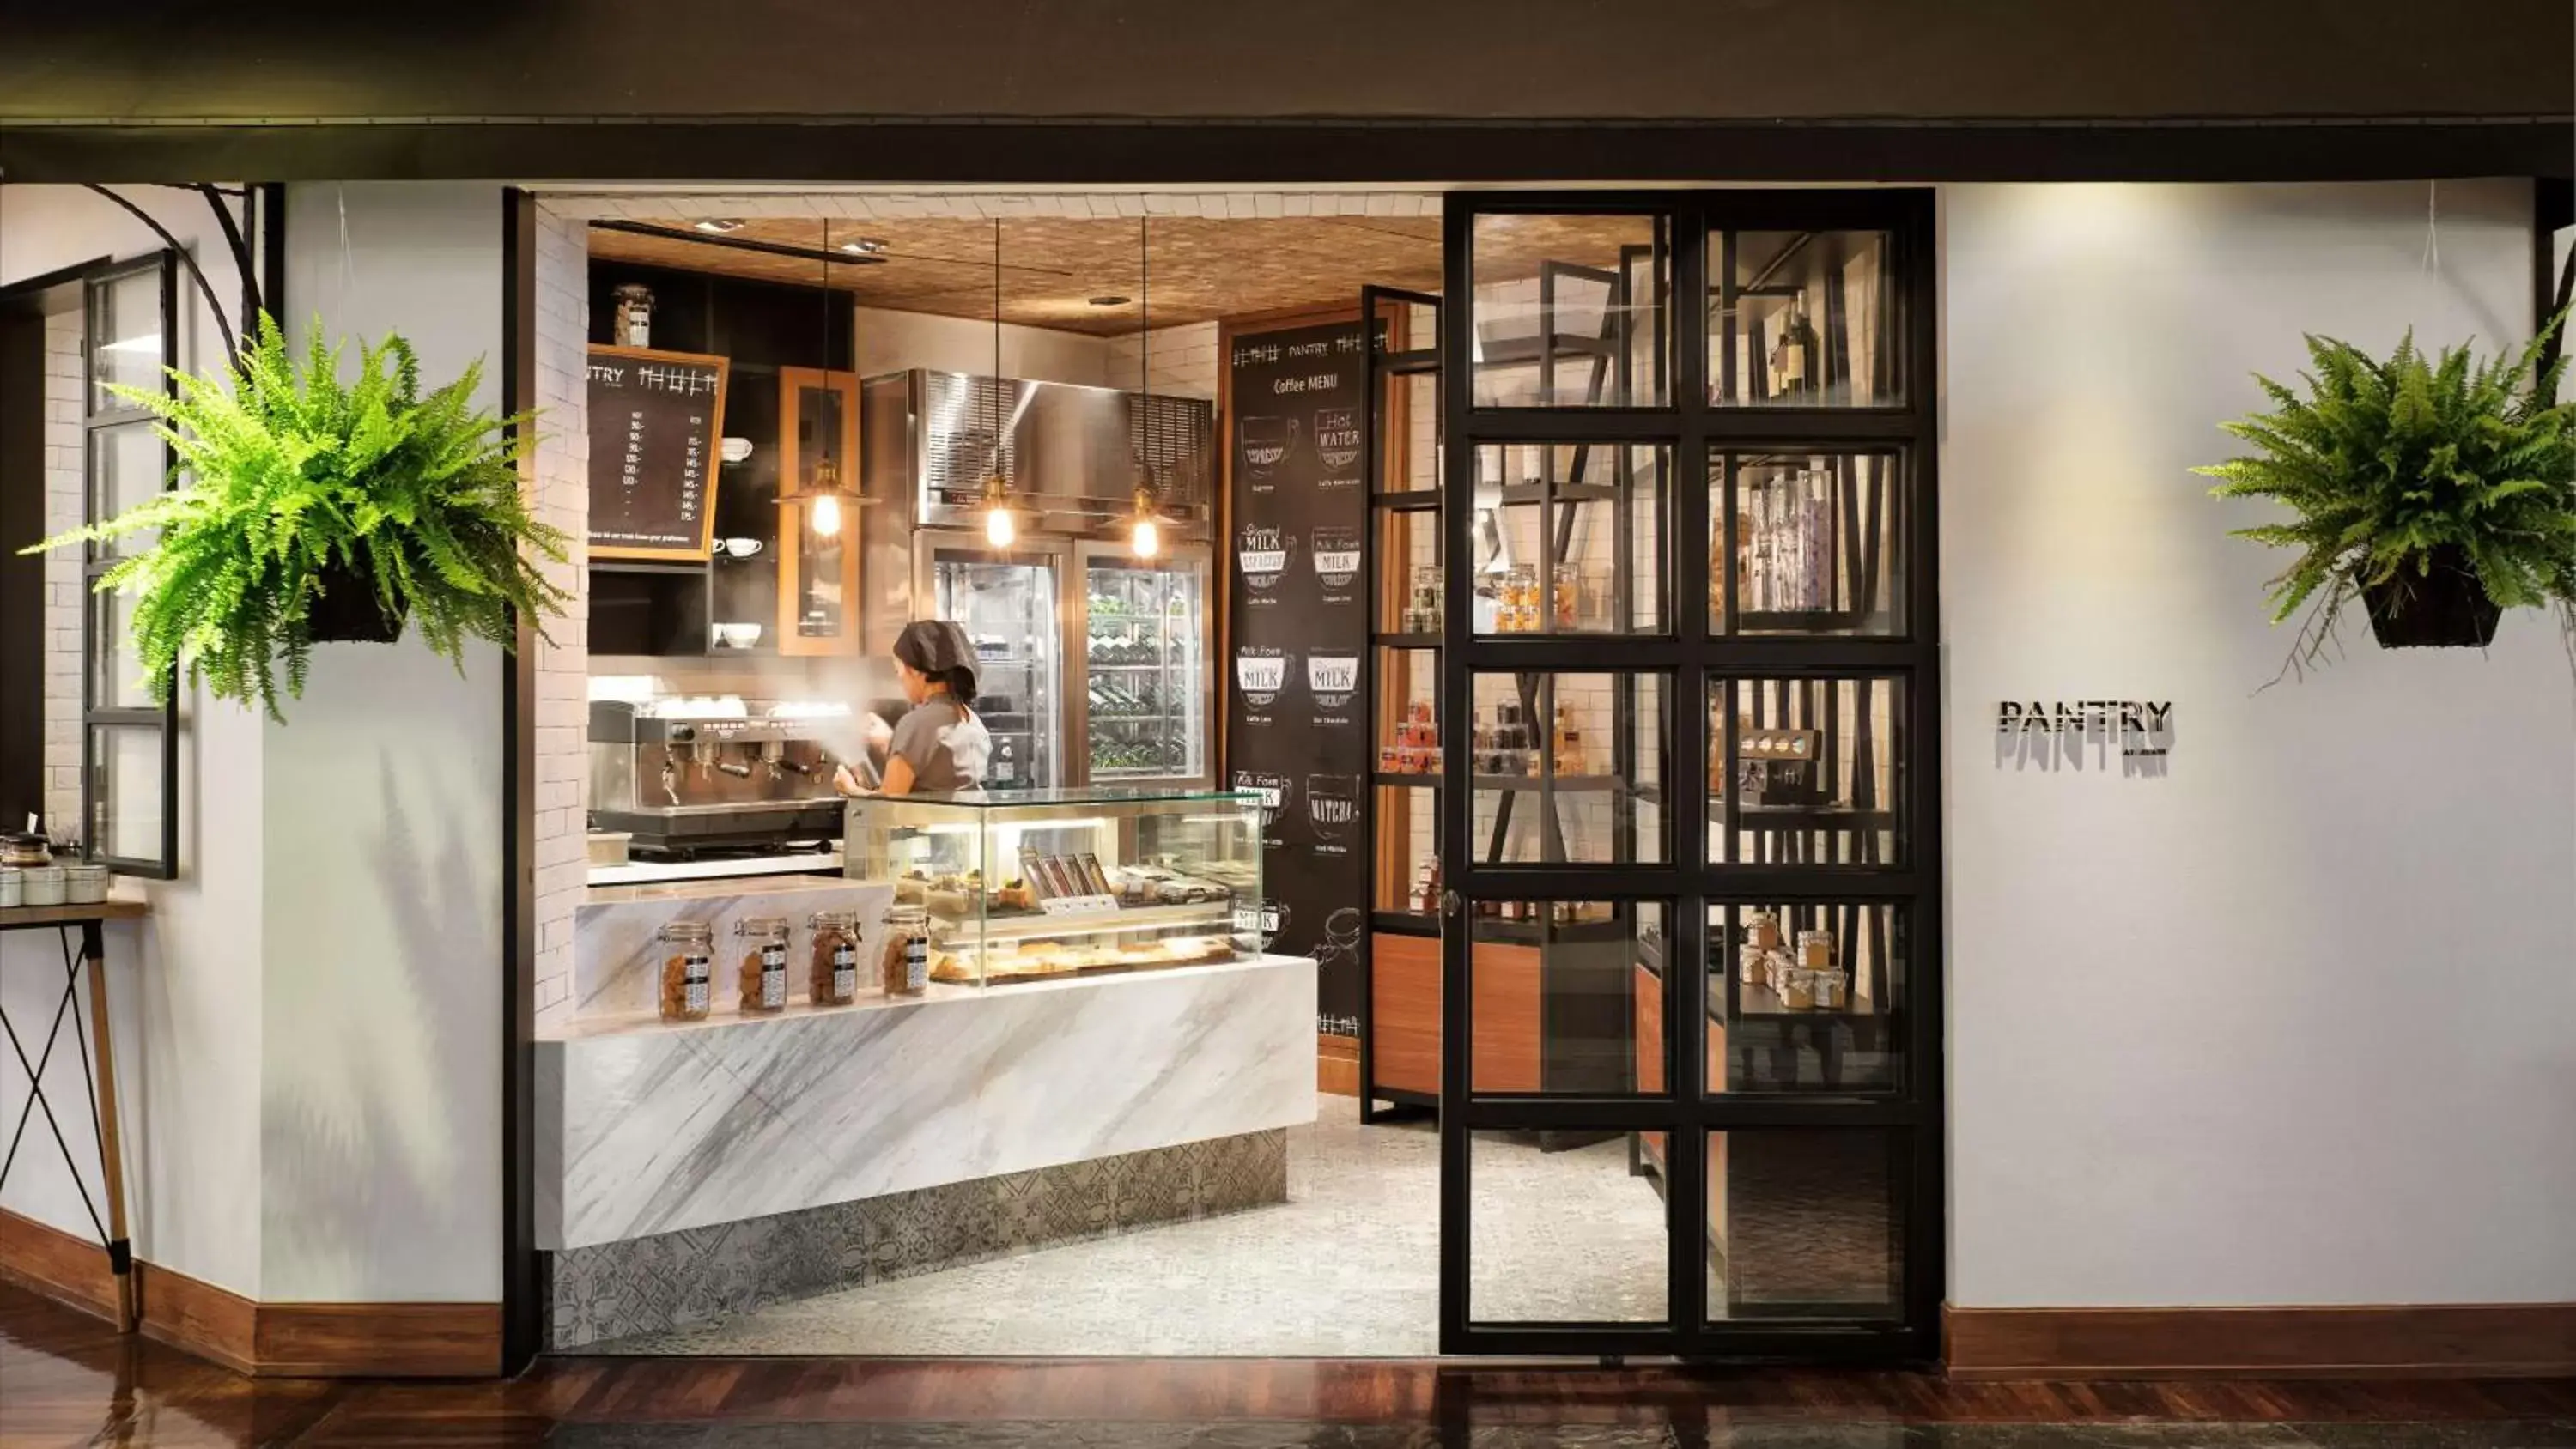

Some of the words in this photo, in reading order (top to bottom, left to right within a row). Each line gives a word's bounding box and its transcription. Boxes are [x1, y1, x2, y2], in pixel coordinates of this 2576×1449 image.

[1288, 343, 1327, 358] PANTRY
[1273, 379, 1305, 395] Coffee
[1307, 374, 1338, 391] MENU
[1325, 413, 1351, 429] Hot
[1319, 430, 1359, 447] WATER
[1245, 535, 1279, 551] MILK
[1322, 555, 1350, 570] MILK
[1244, 671, 1279, 688] MILK
[1314, 670, 1351, 688] MILK
[1999, 700, 2172, 732] PANTRY
[1311, 799, 1352, 823] MATCHA
